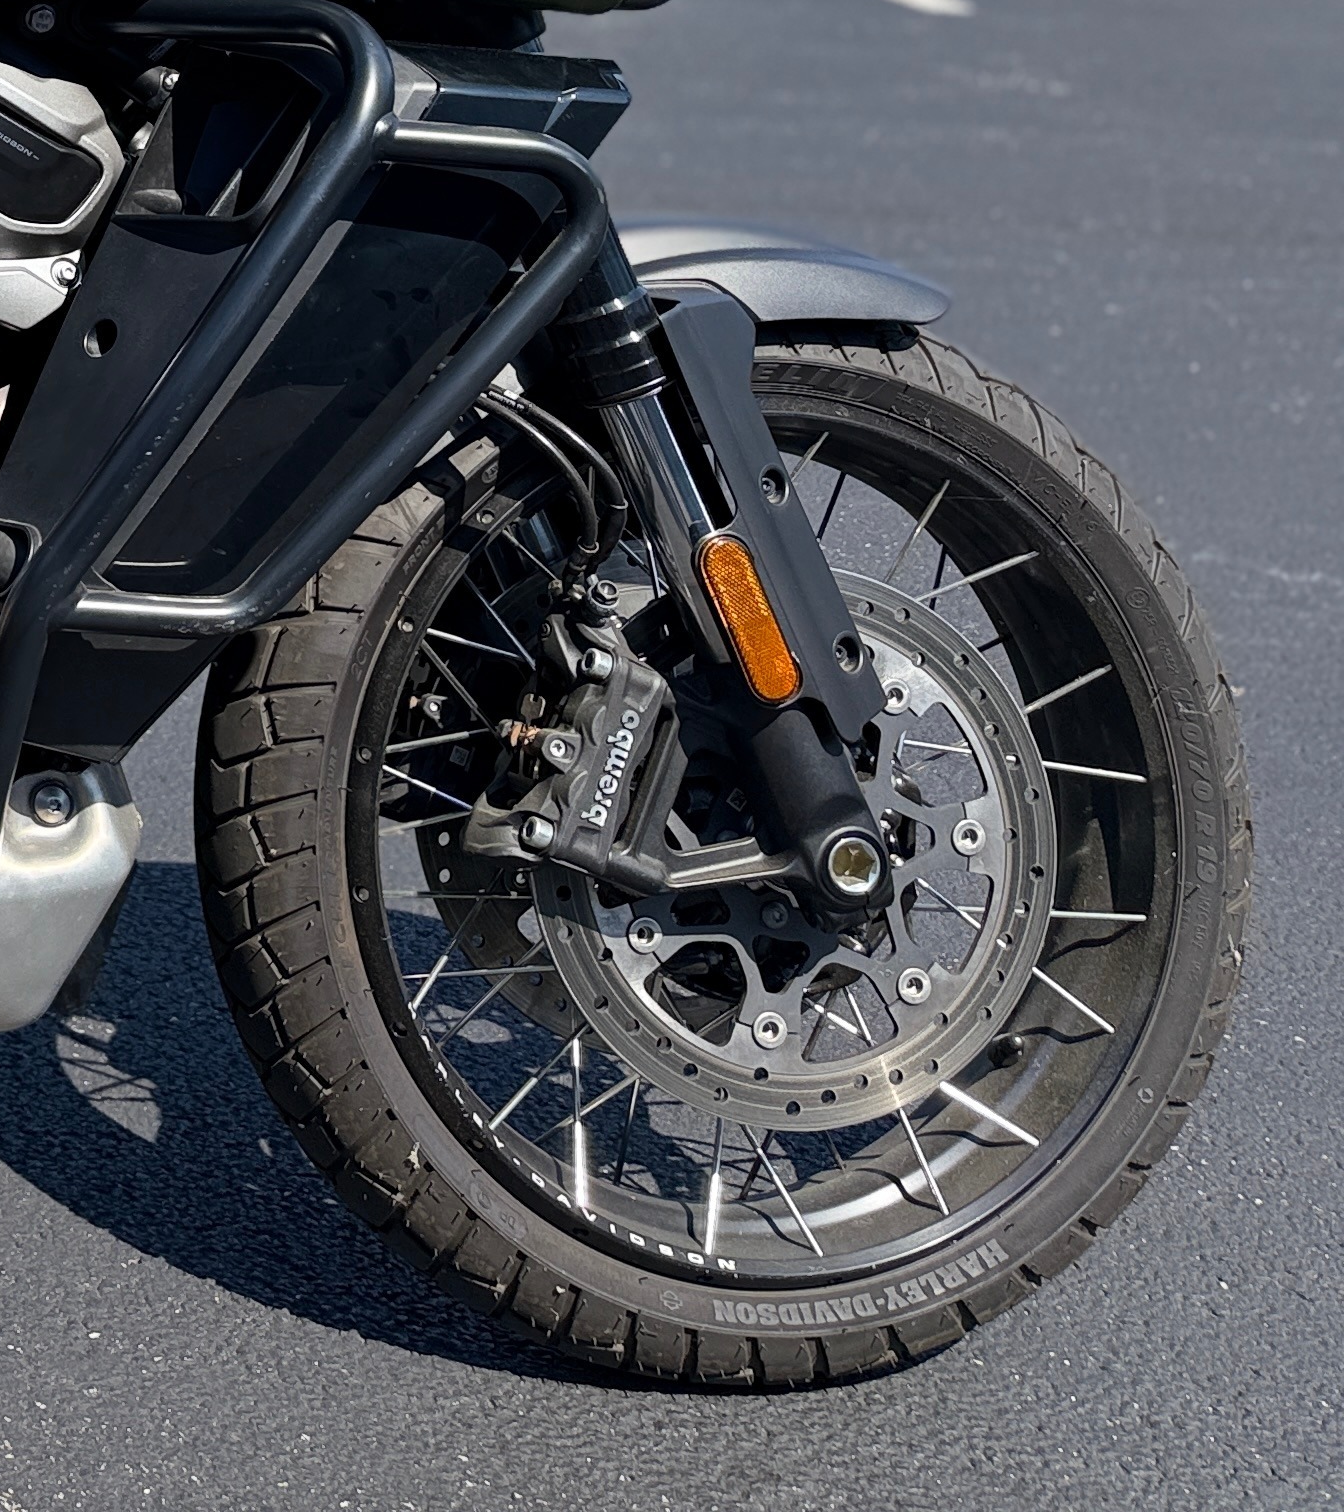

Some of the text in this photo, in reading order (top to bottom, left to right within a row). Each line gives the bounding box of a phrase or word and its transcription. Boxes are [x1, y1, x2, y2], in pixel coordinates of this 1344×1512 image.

[402, 528, 439, 575] FRONT
[580, 709, 640, 828] brembo
[1193, 809, 1215, 838] R
[1195, 846, 1214, 884] 19
[713, 1237, 1010, 1327] HARLEY-DAVIDSON
